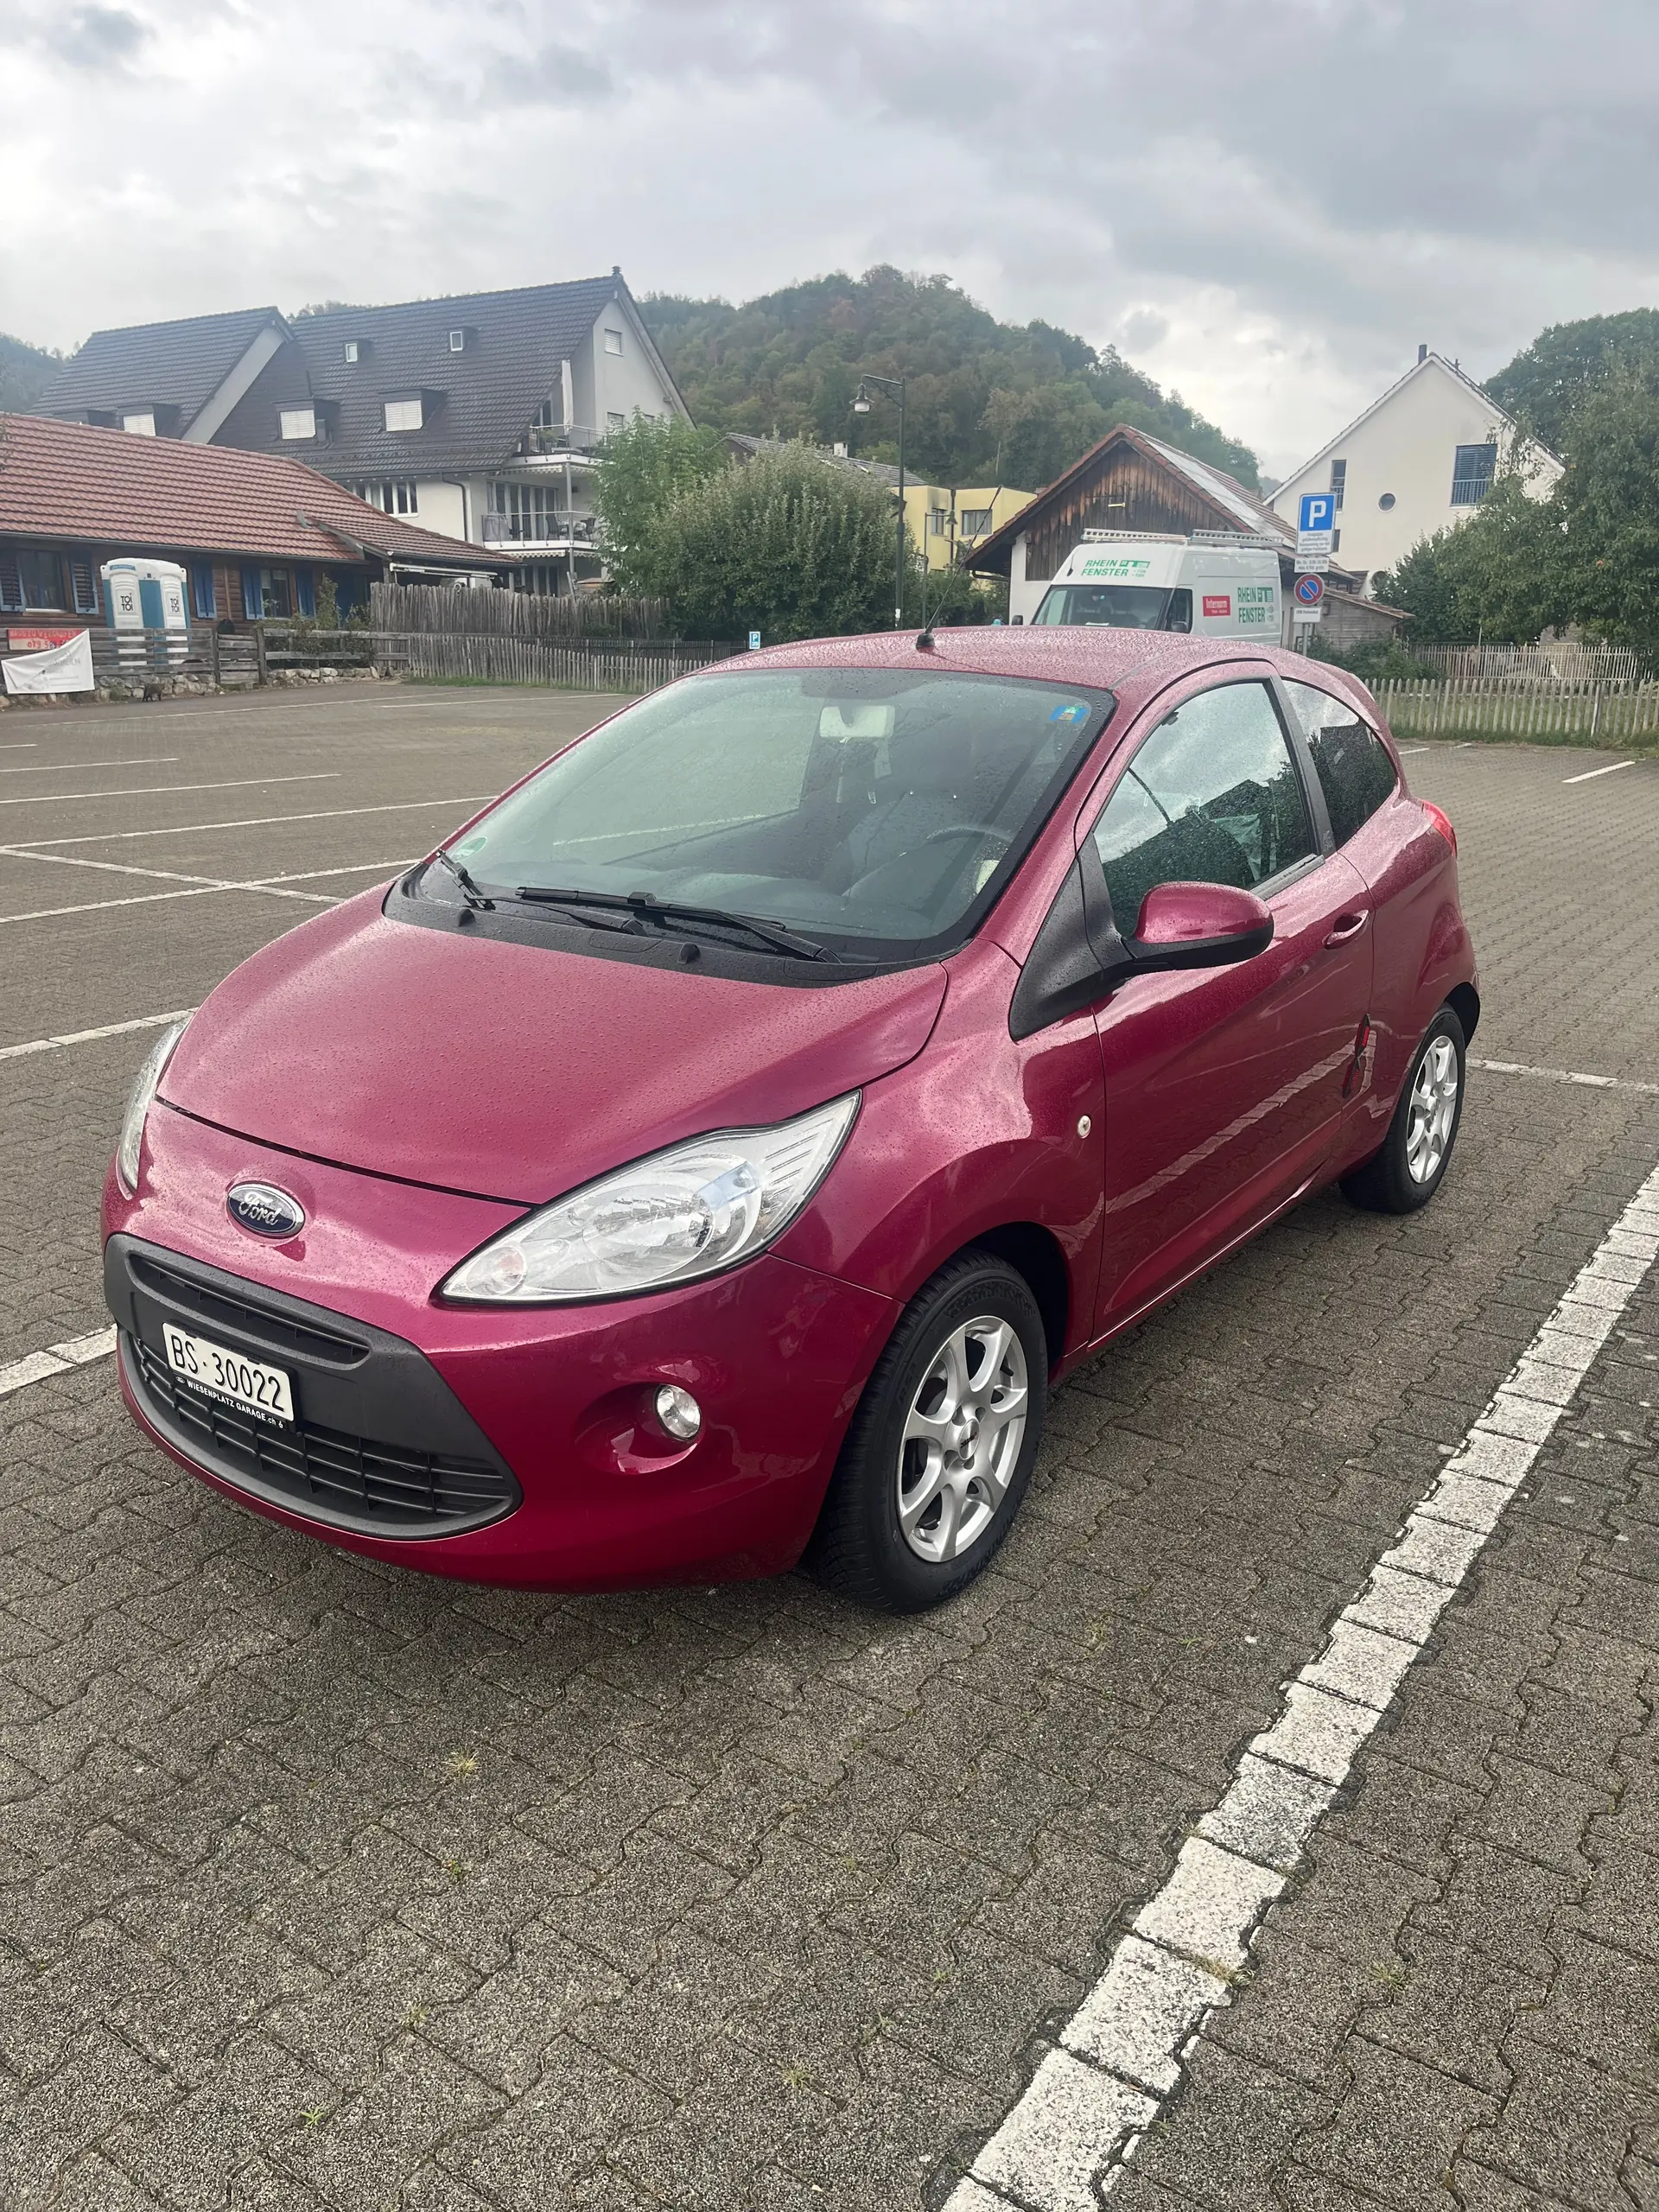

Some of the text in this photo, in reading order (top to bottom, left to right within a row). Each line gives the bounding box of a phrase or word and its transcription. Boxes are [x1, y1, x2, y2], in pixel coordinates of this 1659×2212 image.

[1308, 500, 1326, 528] P
[1237, 588, 1256, 602] RHEIN
[1238, 607, 1265, 623] FENSTER
[238, 1192, 283, 1225] Ford
[187, 1379, 235, 1408] WIESENPLATZ
